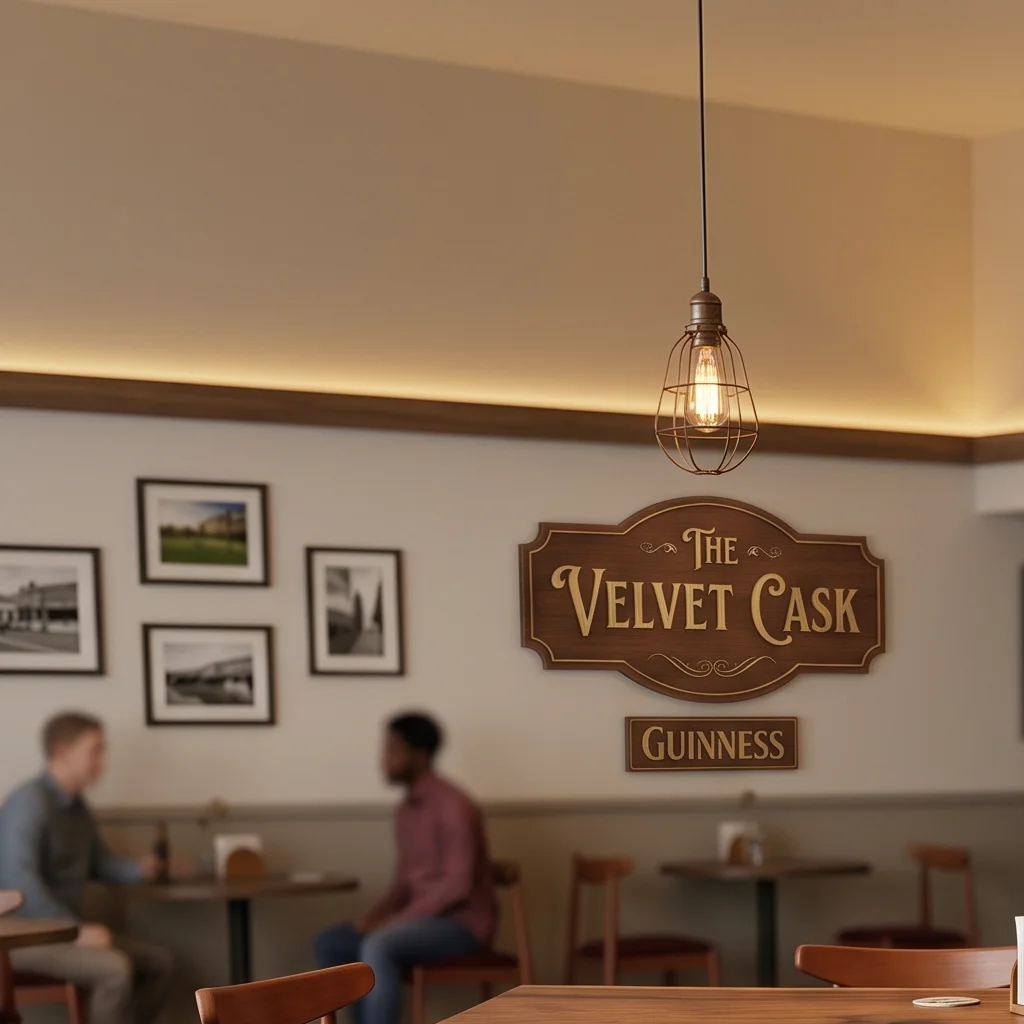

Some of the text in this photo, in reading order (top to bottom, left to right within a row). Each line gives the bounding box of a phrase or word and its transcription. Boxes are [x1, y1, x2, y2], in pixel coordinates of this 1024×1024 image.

[682, 527, 738, 570] THE
[551, 565, 860, 646] VELVET CASK
[642, 726, 785, 760] GUINNESS
